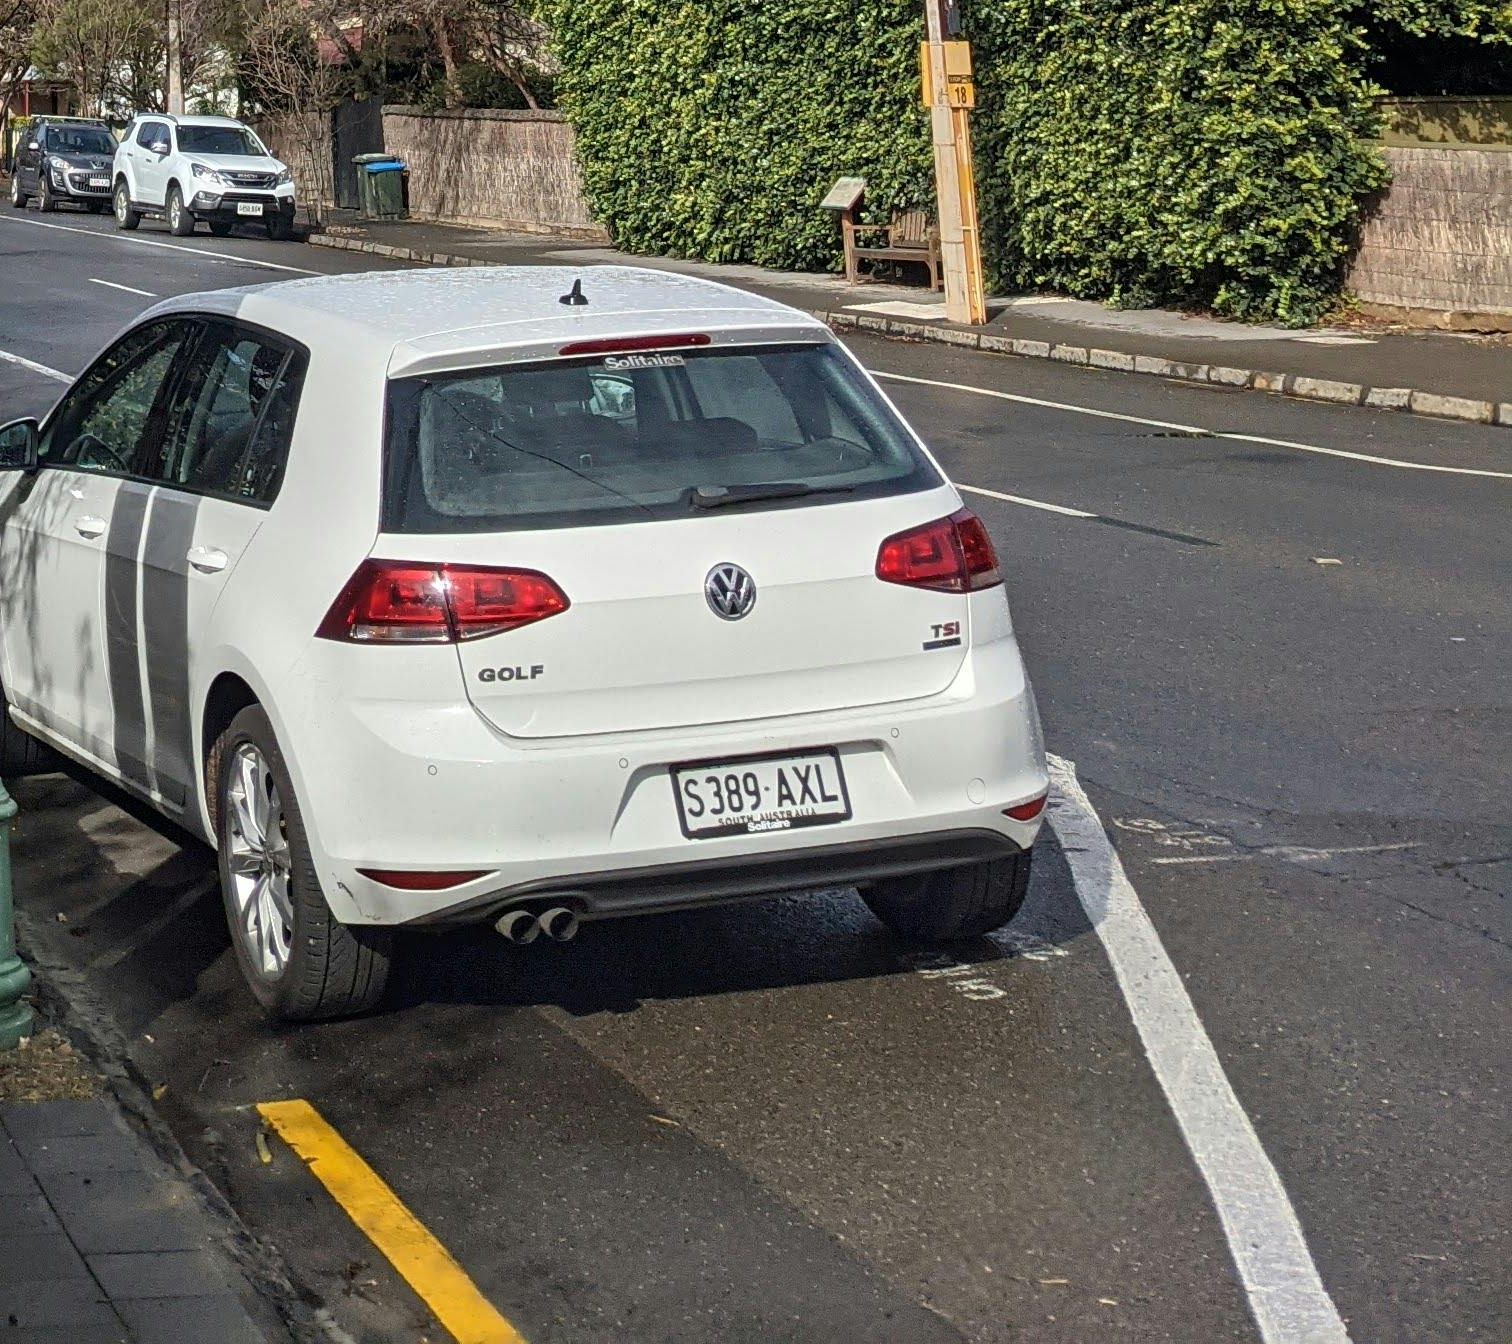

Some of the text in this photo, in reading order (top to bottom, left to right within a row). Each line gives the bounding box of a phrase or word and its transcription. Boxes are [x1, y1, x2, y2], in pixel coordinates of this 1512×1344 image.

[955, 86, 967, 103] 18
[604, 354, 685, 370] Solitaire
[478, 665, 544, 682] GOLF
[747, 819, 791, 832] Solitaire
